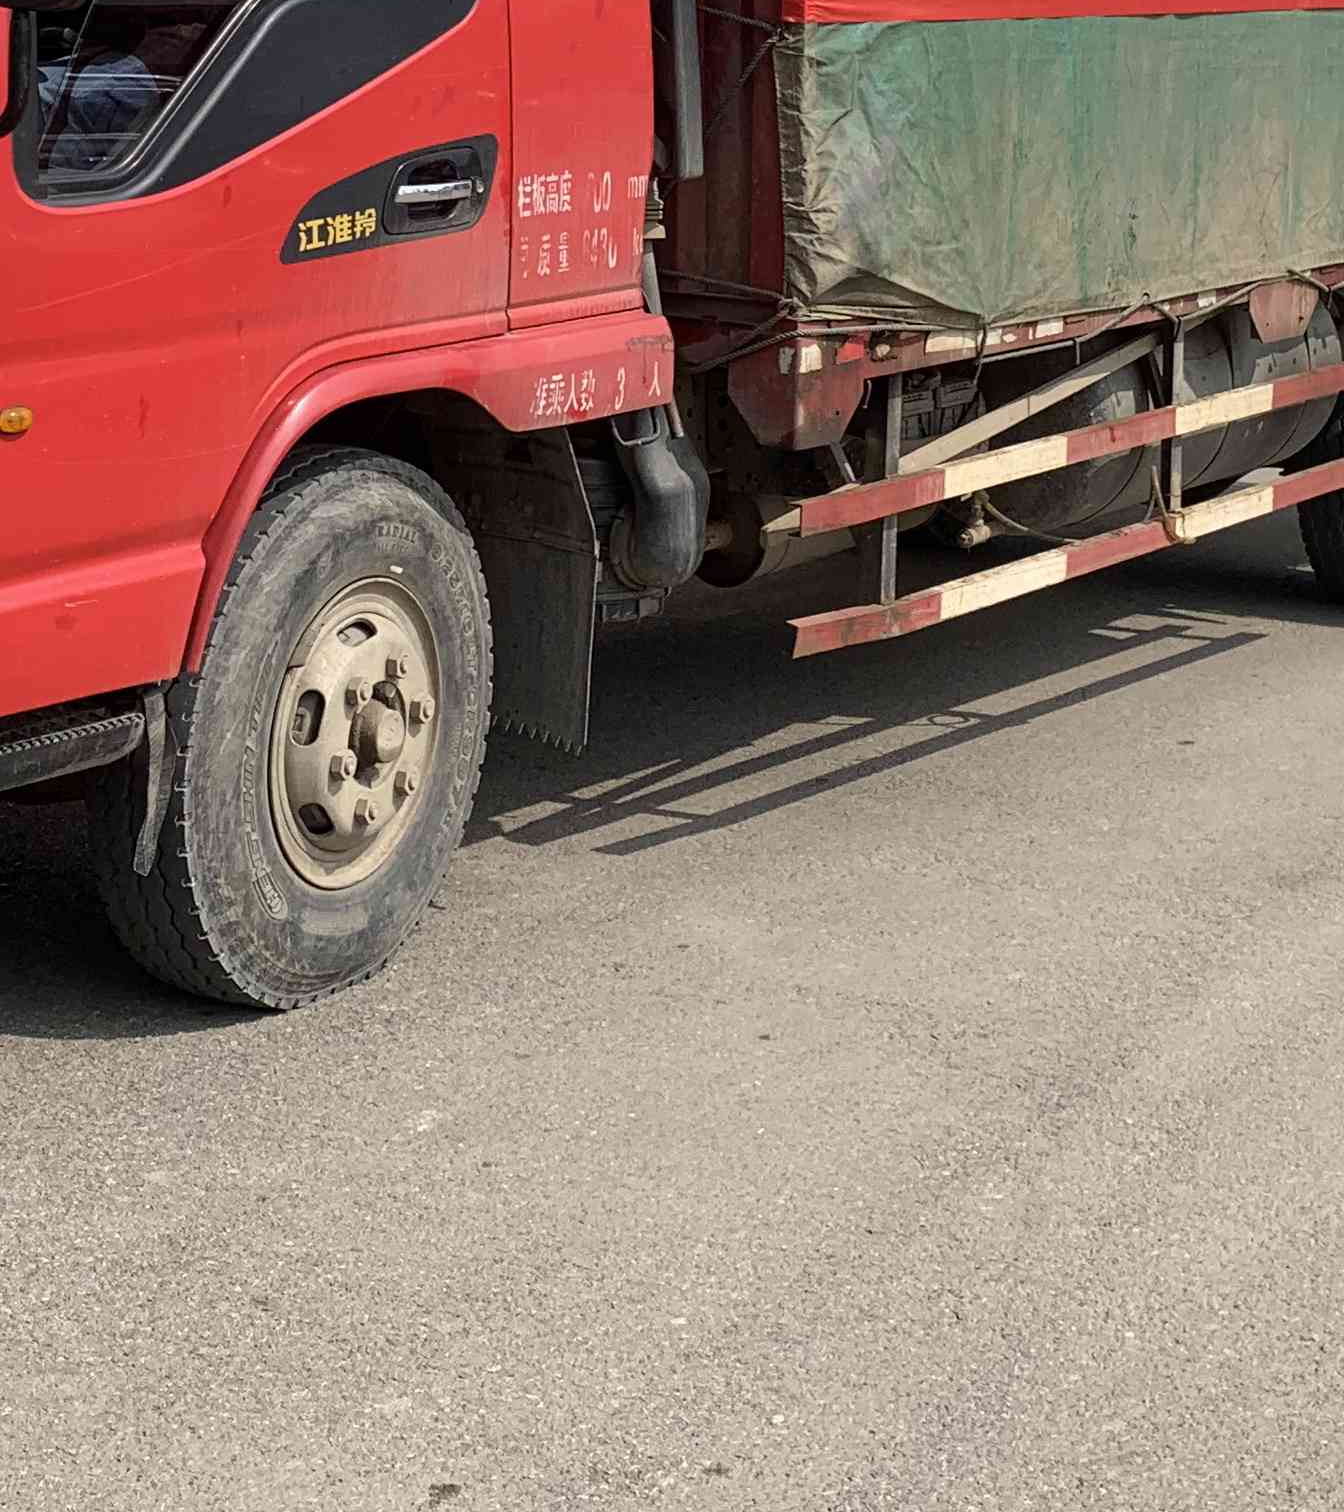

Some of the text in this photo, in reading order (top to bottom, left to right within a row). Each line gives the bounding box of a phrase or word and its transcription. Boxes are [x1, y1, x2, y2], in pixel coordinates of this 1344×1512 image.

[517, 170, 573, 218] 栏板高度
[529, 361, 662, 417] 准乘人数 3 人
